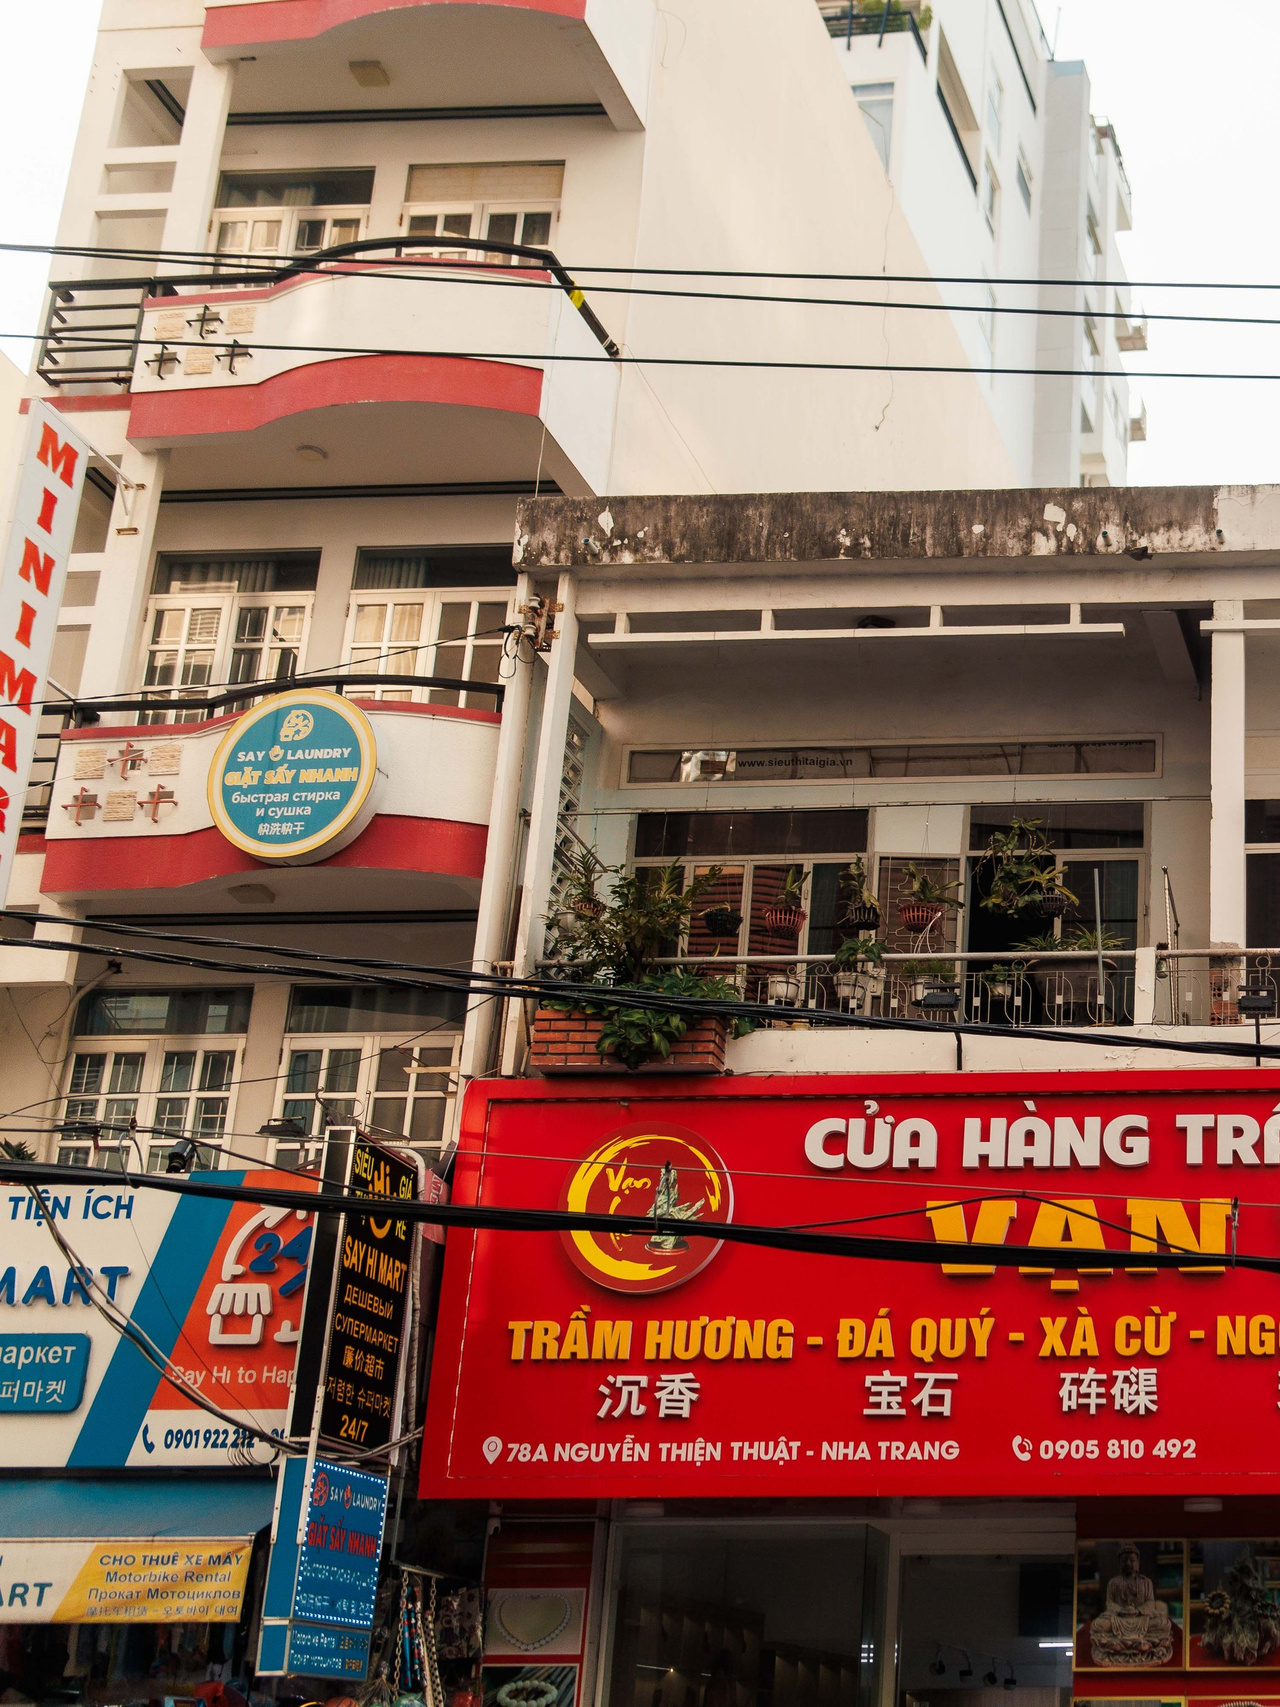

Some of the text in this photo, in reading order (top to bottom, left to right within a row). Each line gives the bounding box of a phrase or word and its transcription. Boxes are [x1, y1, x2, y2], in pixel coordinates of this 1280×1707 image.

[237, 748, 352, 762] SAY LAUNDRY
[224, 764, 359, 788] GIẶT SẤY NHANH
[231, 791, 341, 804] быстрая стирка
[255, 806, 312, 819] и сушка
[805, 1100, 938, 1169] CỬA
[962, 1101, 1150, 1168] HÀNG
[8, 1188, 134, 1227] TIỆN ÍCH
[926, 1198, 1233, 1293] VẠN
[343, 1235, 407, 1293] SAY HI MART
[343, 1284, 394, 1320] ДЕШЕВЫЙ
[335, 1313, 399, 1354] СУПЕРМАРКЕТ
[509, 1305, 633, 1360] TRẦM
[645, 1315, 795, 1360] HƯƠNG
[806, 1336, 823, 1346] -
[837, 1308, 895, 1358] ĐÁ
[911, 1308, 995, 1361] QUÝ
[1009, 1332, 1025, 1342] -
[1039, 1307, 1099, 1357] XÀ
[1115, 1306, 1177, 1356] CỪ
[1190, 1330, 1205, 1340] -
[0, 1345, 76, 1370] аркет
[342, 1345, 385, 1381] 廉价超市
[171, 1366, 206, 1388] Say
[237, 1367, 257, 1384] to
[1058, 1366, 1158, 1415] 砗磲
[597, 1373, 701, 1419] 沉香
[862, 1370, 959, 1417] 宝石
[164, 1428, 200, 1449] 0901
[203, 1428, 229, 1449] 922
[339, 1414, 369, 1443] 24/7
[507, 1443, 549, 1462] 78A
[553, 1434, 650, 1463] NGUYỄN
[658, 1437, 722, 1467] THIỆN
[731, 1436, 801, 1466] THUẬT
[821, 1441, 871, 1461] NHA
[877, 1441, 960, 1461] TRANG
[1039, 1439, 1197, 1460] 0905 810 492
[330, 1486, 382, 1512] SAY LAUNDRY
[347, 1530, 378, 1558] NHANH
[99, 1554, 136, 1566] CHO
[141, 1551, 180, 1566] THUÊ
[184, 1554, 203, 1566] XE
[105, 1571, 232, 1583] Motorbike Rental
[87, 1588, 241, 1602] Прокат Мотоциклов
